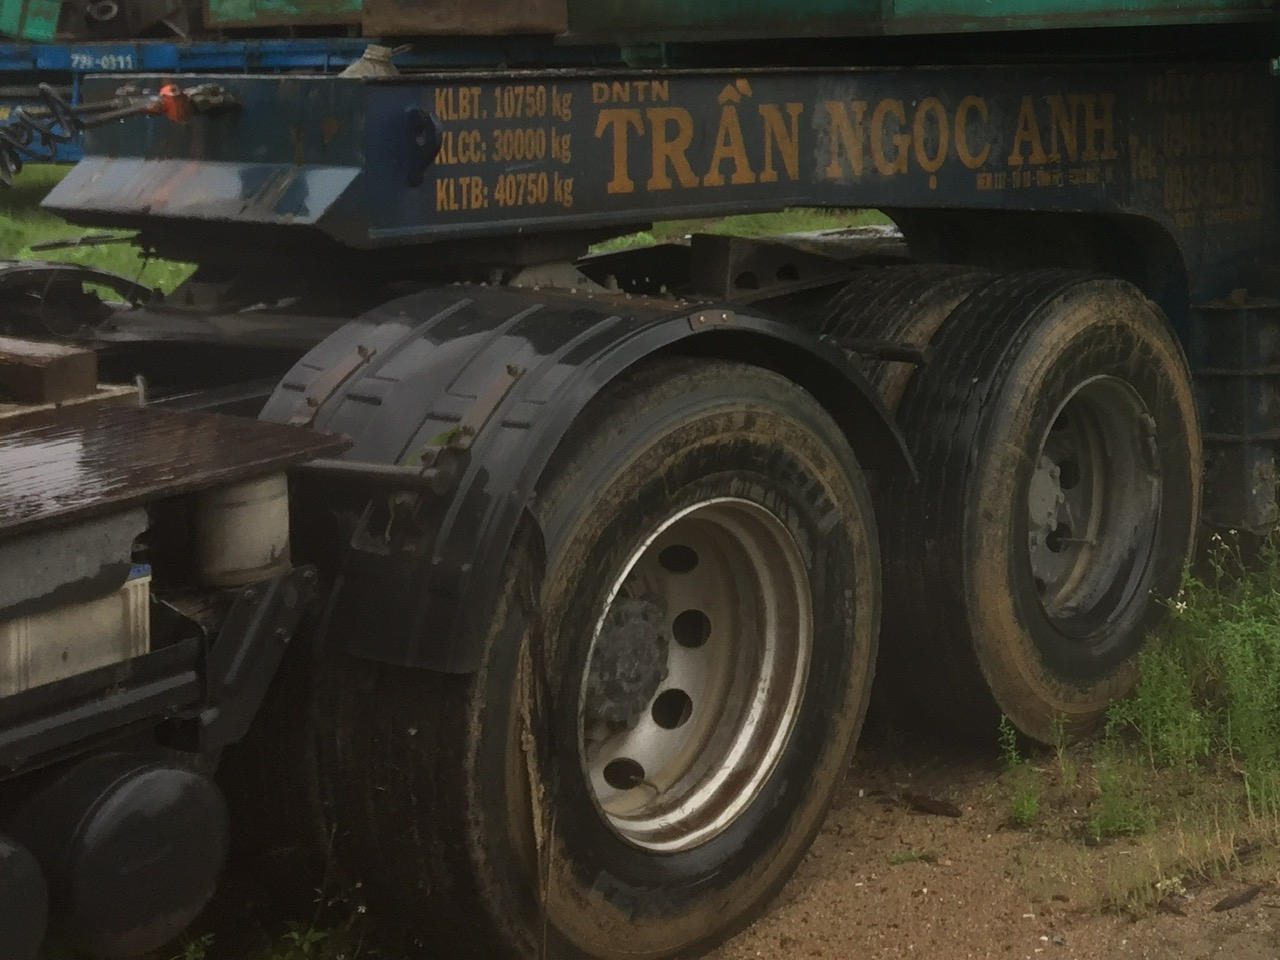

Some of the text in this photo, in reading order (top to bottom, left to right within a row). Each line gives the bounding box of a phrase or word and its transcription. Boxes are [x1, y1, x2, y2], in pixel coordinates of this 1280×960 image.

[494, 85, 547, 119] 10750
[552, 85, 573, 122] kg
[592, 80, 670, 104] DNTN
[493, 128, 546, 162] 30000
[551, 126, 572, 164] kg
[594, 78, 800, 195] TRẦN
[825, 94, 992, 191] NGỌC
[1007, 93, 1118, 167] ANH
[436, 171, 574, 212] KLTB: 40750 kg
